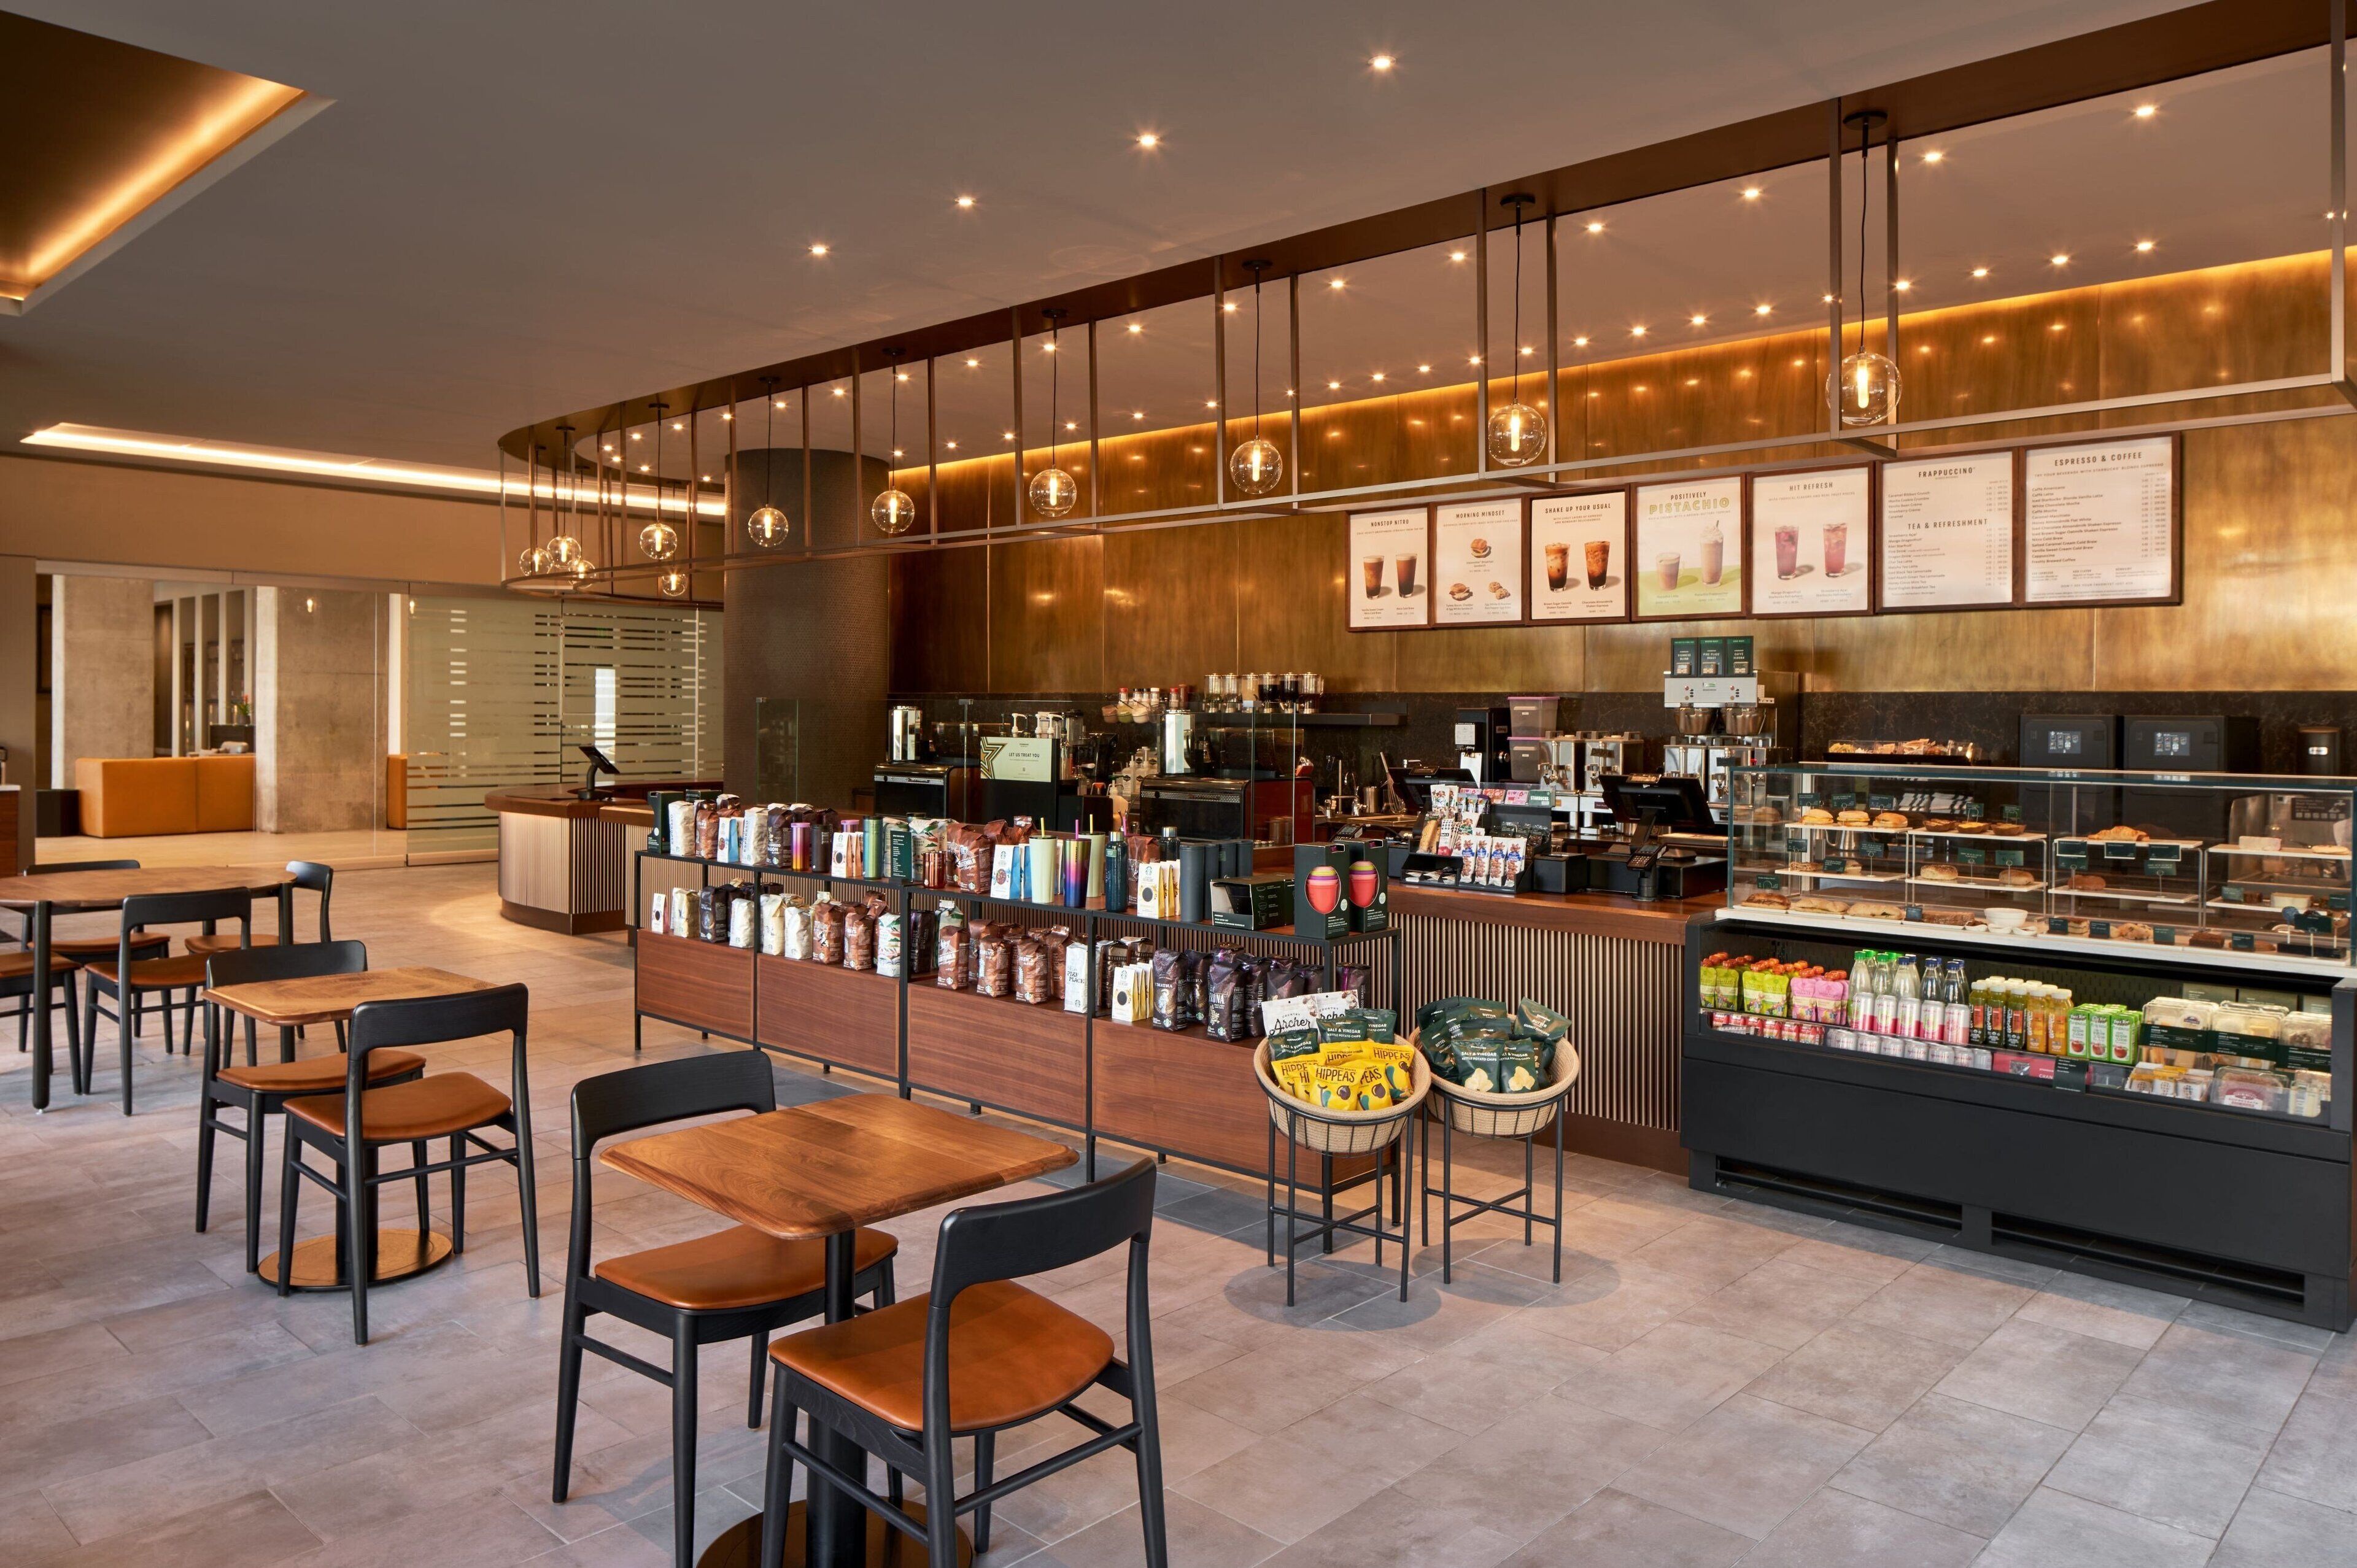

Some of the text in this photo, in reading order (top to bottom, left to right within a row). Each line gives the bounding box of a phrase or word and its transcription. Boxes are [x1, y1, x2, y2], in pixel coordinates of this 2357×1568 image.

[2054, 455, 2097, 467] ESPRESSO
[2111, 451, 2143, 462] COFFEE
[1803, 482, 1833, 490] REFRESH
[1670, 491, 1706, 500] POSITIVELY
[1649, 497, 1730, 514] PISTACHIO
[1933, 518, 1988, 528] REFRESHMENT
[1269, 1016, 1311, 1036] Archer
[1532, 1019, 1547, 1028] BUTTER
[1293, 1041, 1312, 1049] VINEGAR
[1374, 1049, 1411, 1060] HIPPEAS
[1315, 1068, 1355, 1083] HIPPEAS
